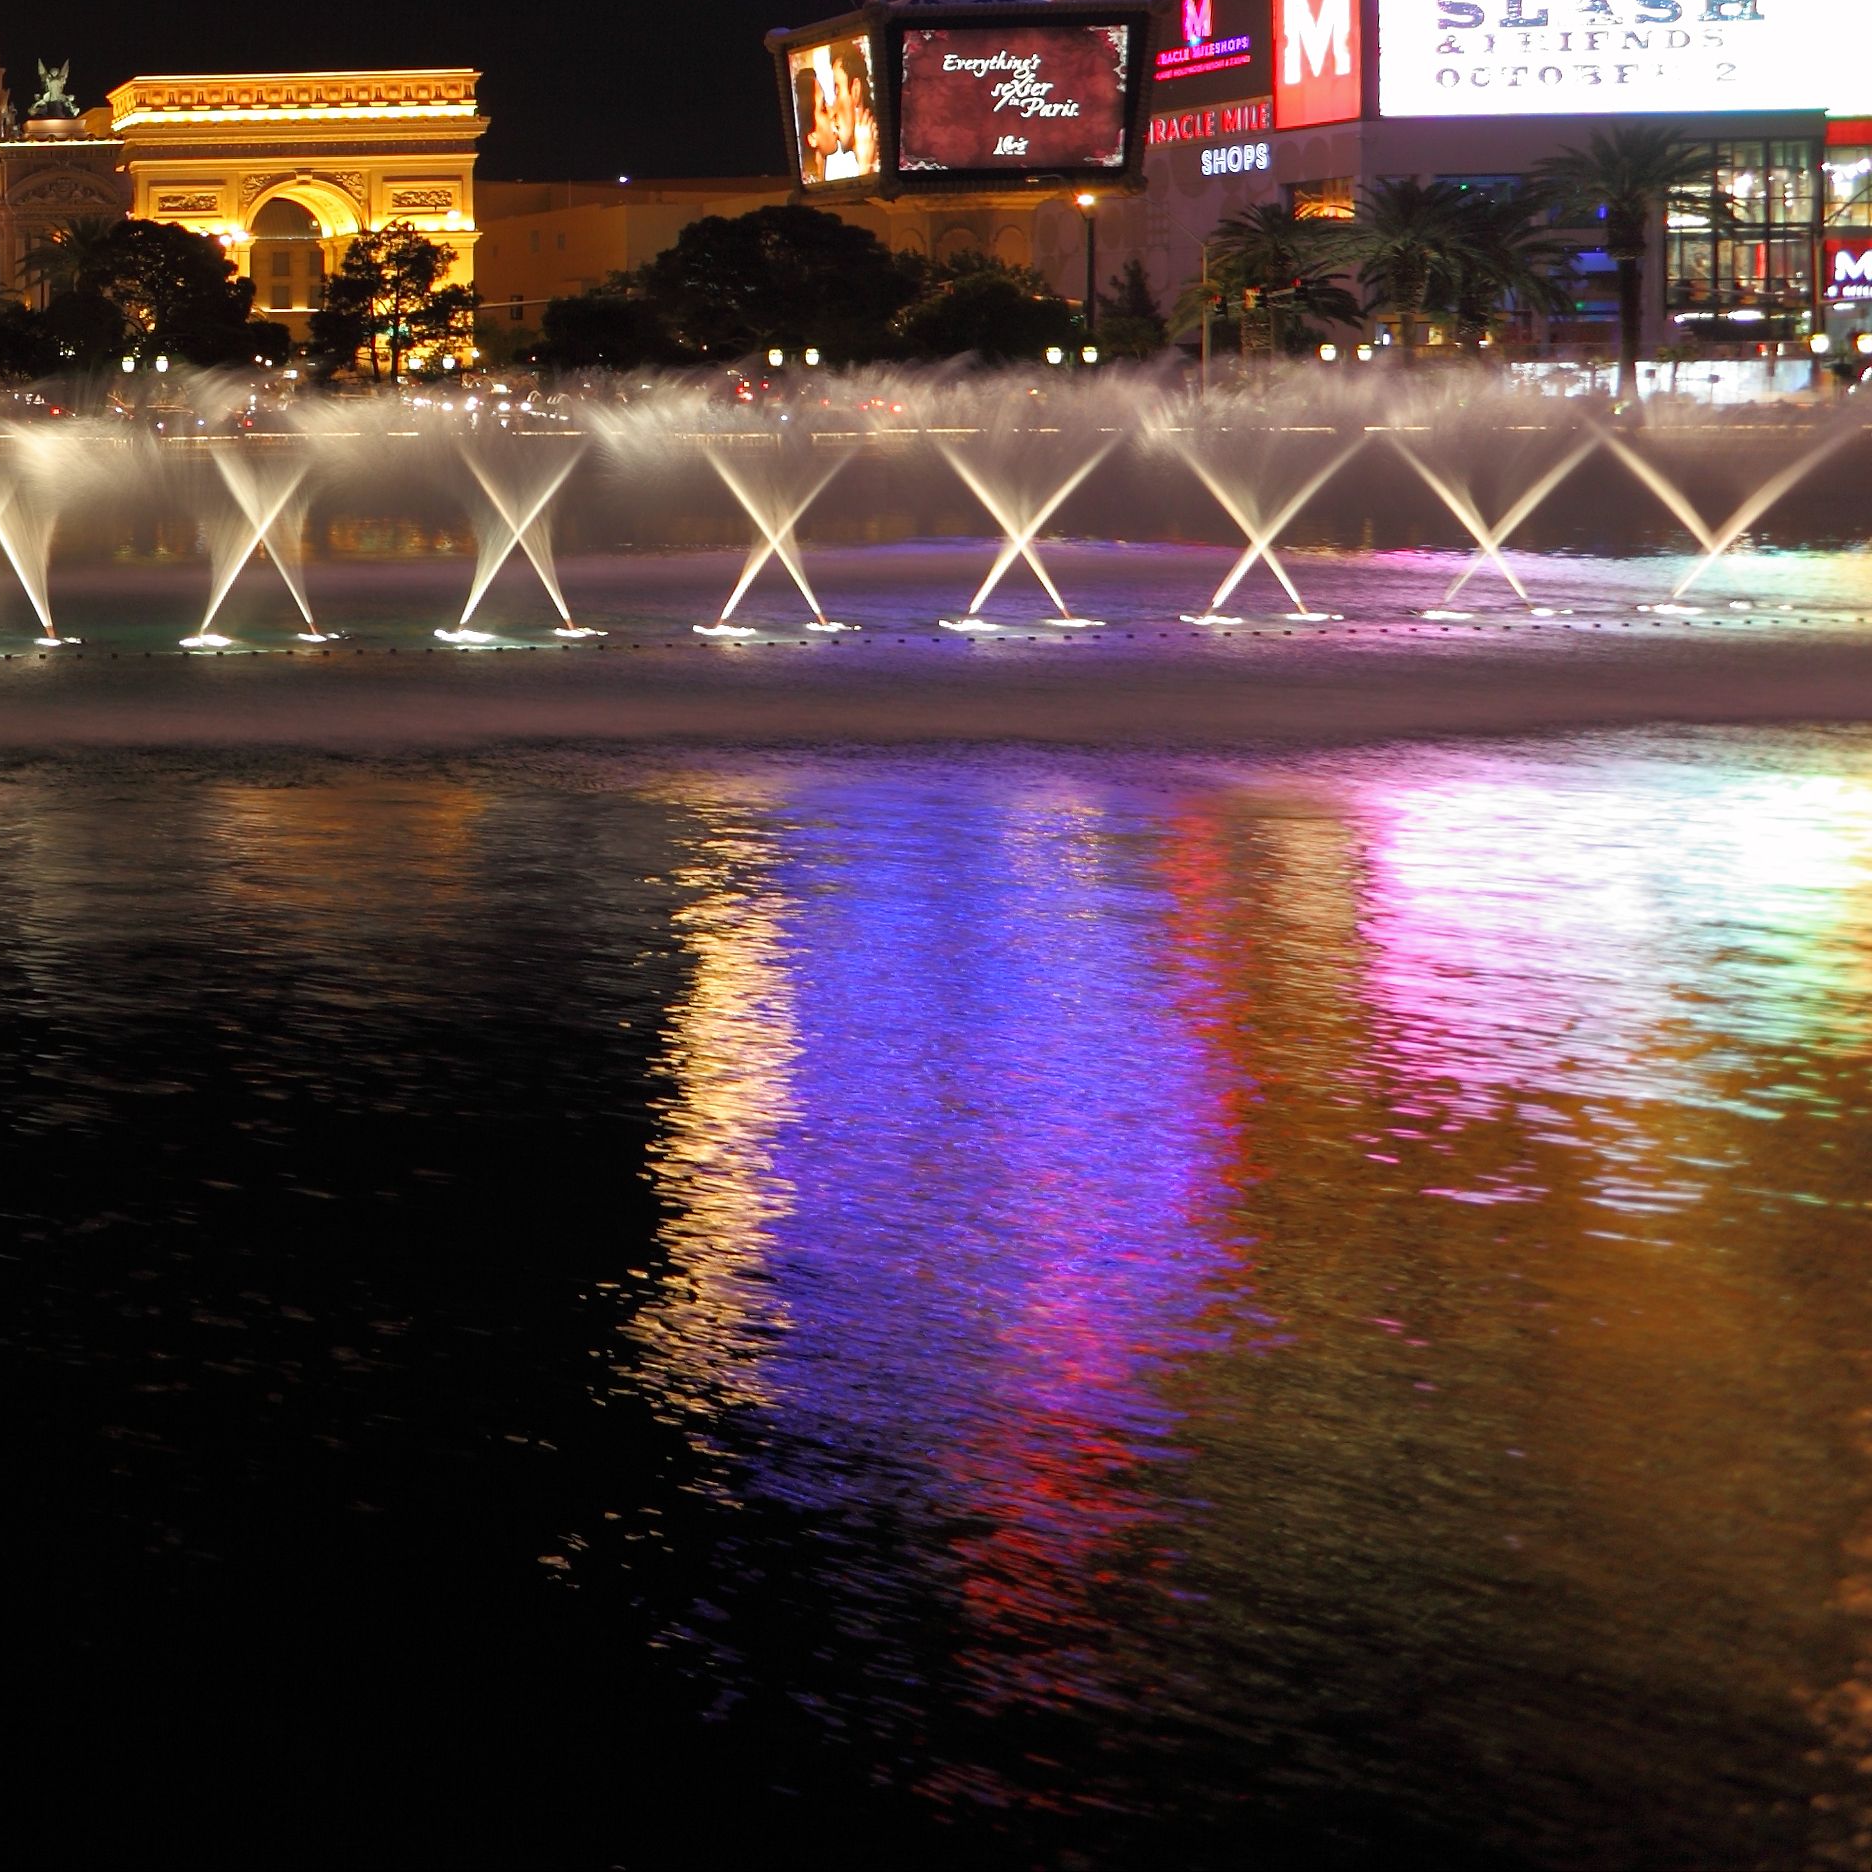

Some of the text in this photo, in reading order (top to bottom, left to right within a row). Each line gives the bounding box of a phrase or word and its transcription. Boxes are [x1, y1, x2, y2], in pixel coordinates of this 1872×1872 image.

[1214, 36, 1248, 54] SHOPS
[1436, 34, 1464, 54] &
[942, 50, 1042, 79] Everything's
[1436, 64, 1668, 88] OCTOBE
[1144, 102, 1271, 145] IRACLE MILE
[1201, 142, 1269, 176] SHOPS
